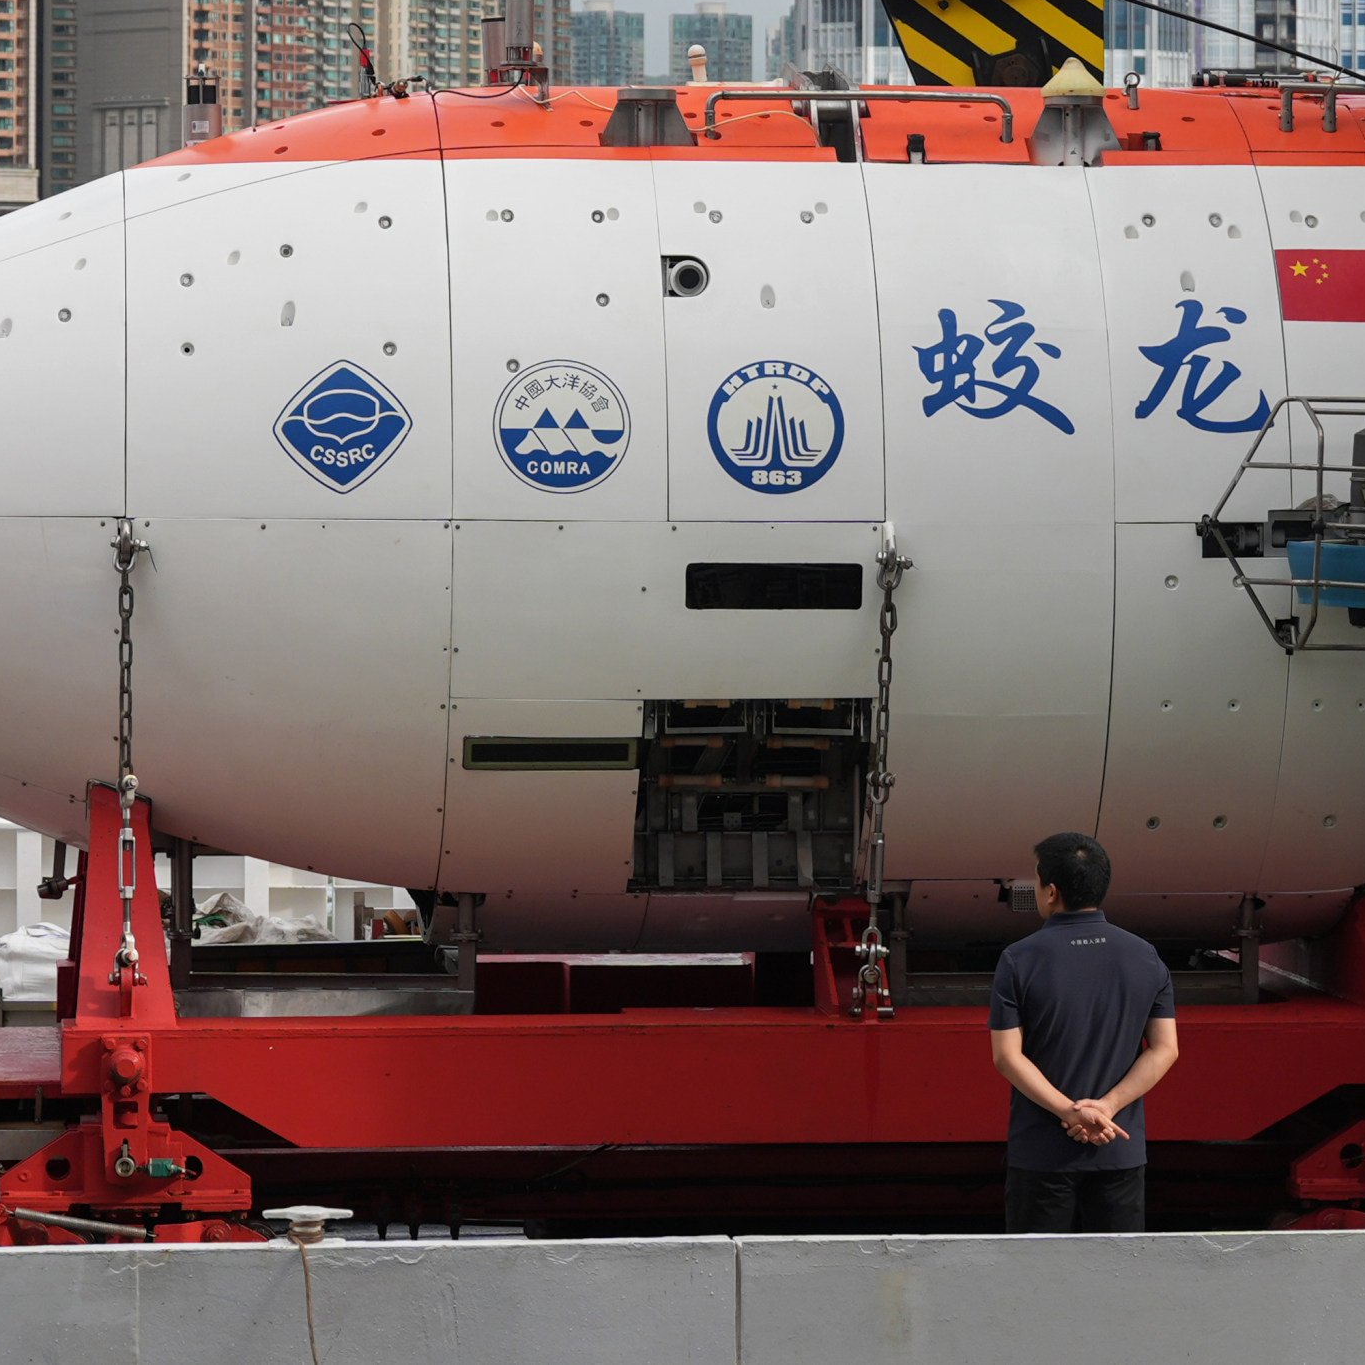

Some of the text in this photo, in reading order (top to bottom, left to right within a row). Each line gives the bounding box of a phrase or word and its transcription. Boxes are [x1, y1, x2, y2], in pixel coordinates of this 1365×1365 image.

[722, 362, 830, 396] HTRDP
[911, 299, 1275, 435] 蛟龙
[514, 372, 610, 413] 中國大洋協會
[310, 443, 376, 468] CSSRC
[526, 460, 591, 475] COMRA
[751, 470, 803, 486] 863
